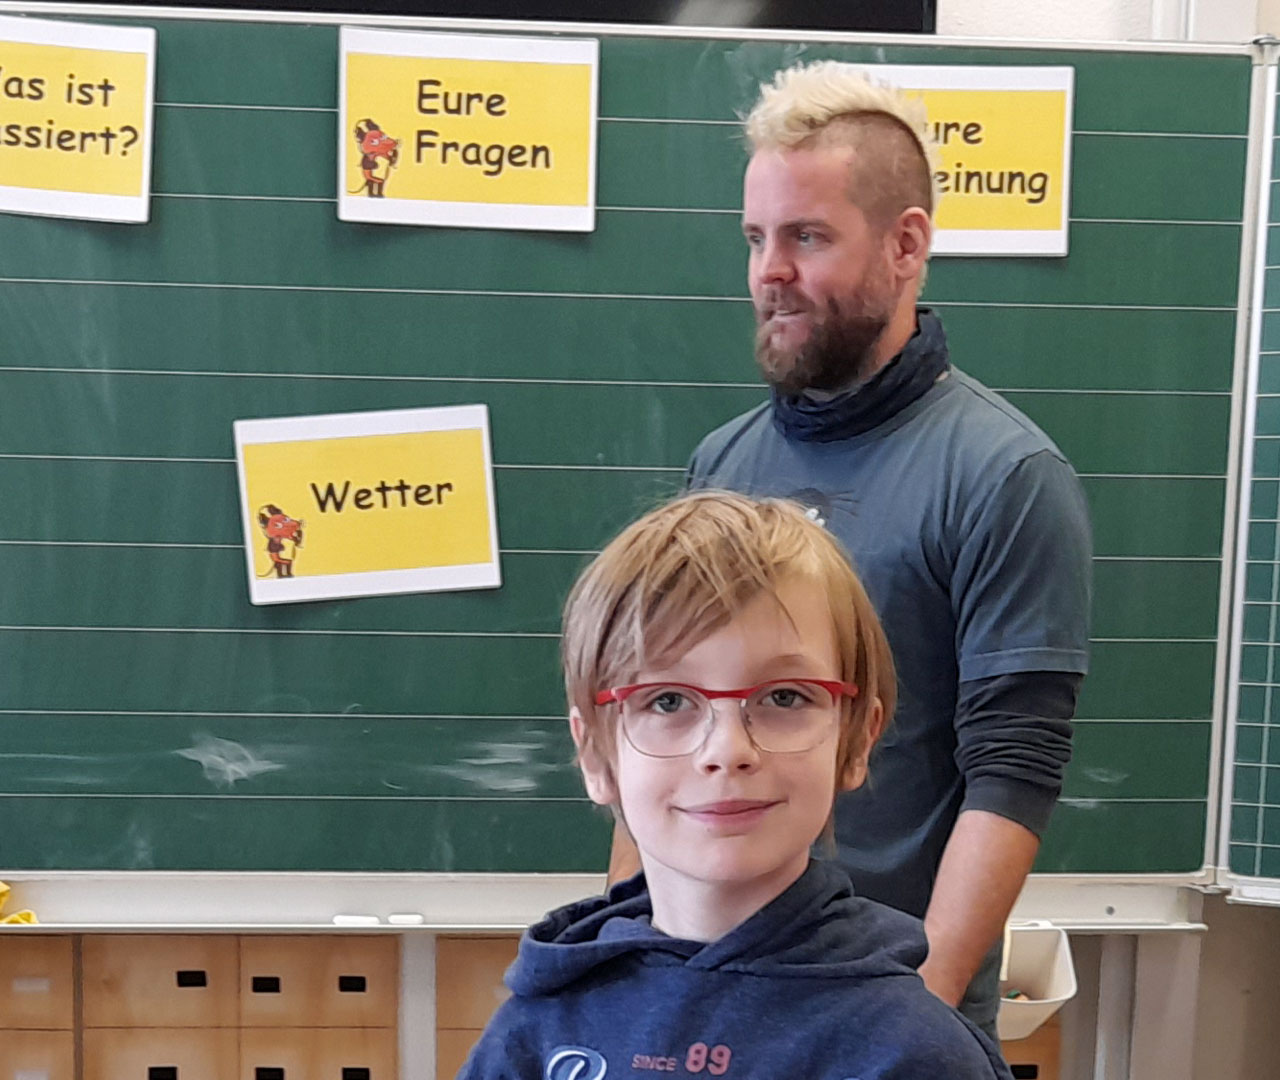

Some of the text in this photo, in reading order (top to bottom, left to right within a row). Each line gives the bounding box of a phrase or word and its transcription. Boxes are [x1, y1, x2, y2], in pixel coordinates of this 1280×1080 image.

[65, 72, 116, 107] ist
[416, 78, 507, 118] Eure
[414, 129, 552, 173] Fragen
[923, 121, 983, 145] ure
[933, 161, 1049, 204] einung
[310, 478, 453, 514] Wetter
[630, 1041, 733, 1076] SINCE 89
